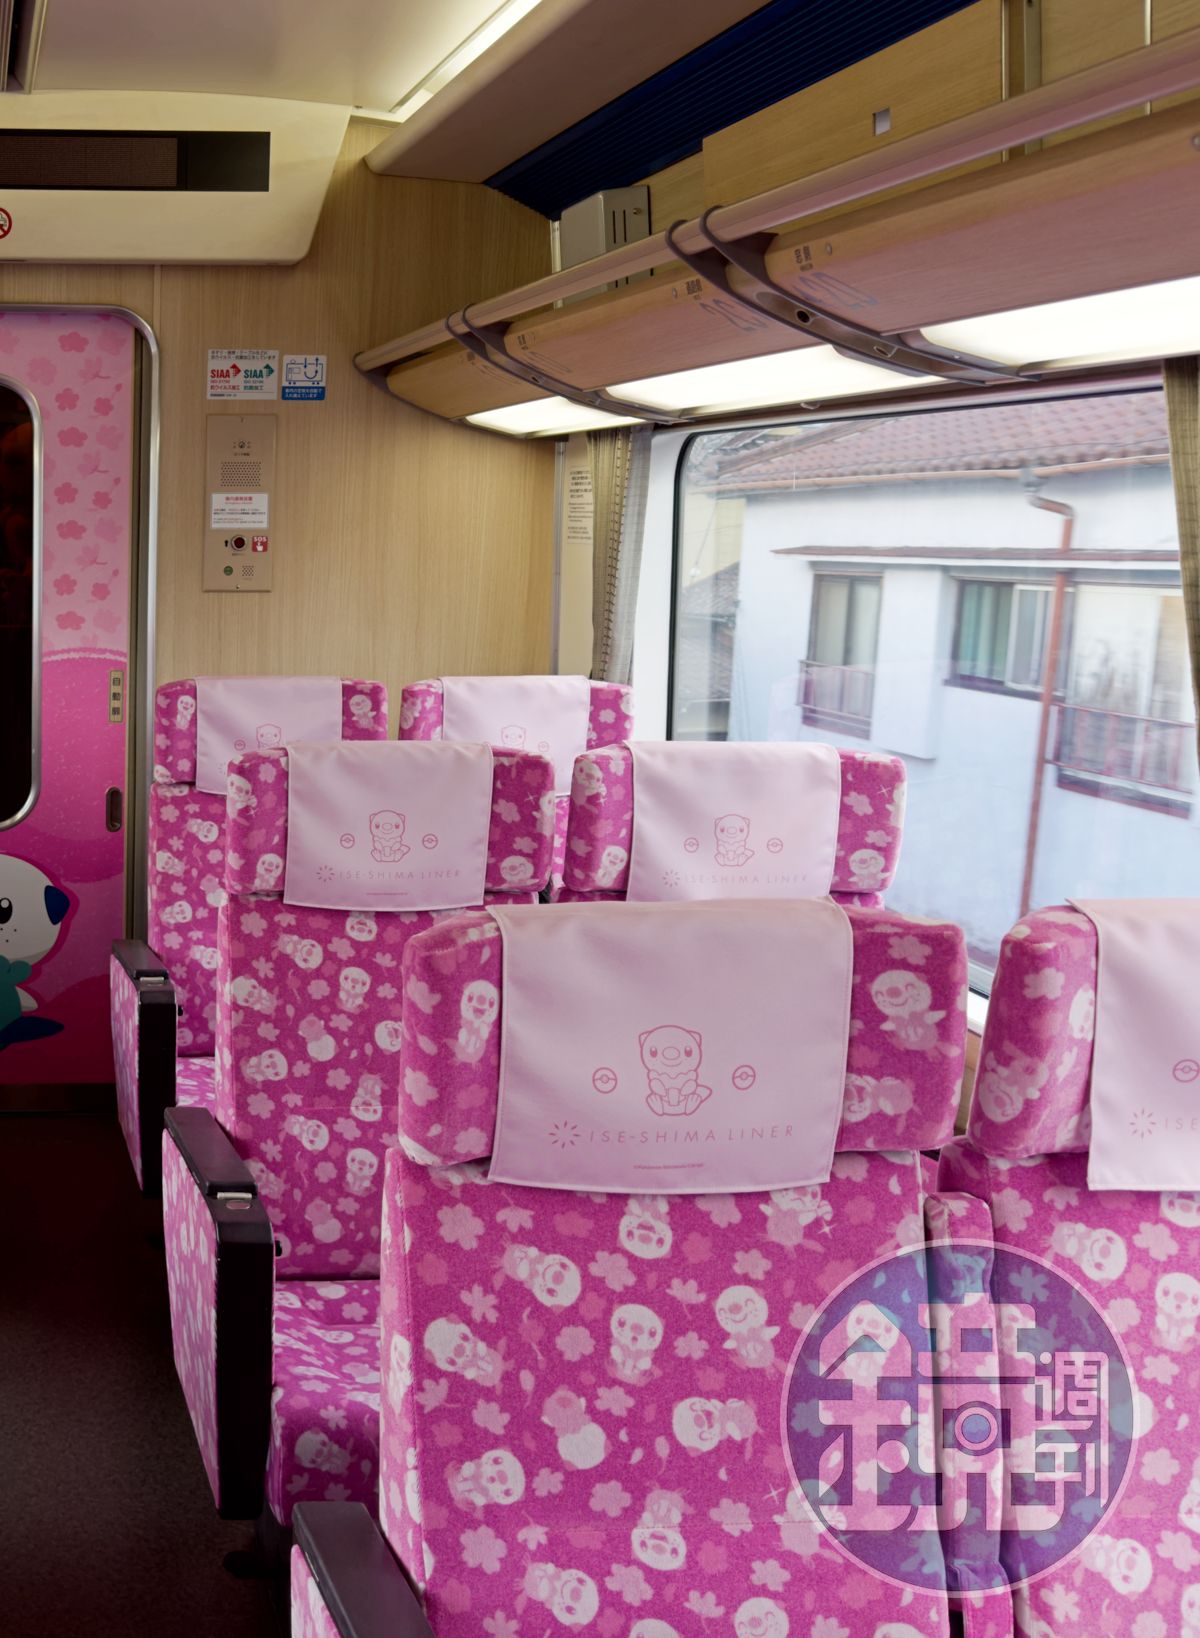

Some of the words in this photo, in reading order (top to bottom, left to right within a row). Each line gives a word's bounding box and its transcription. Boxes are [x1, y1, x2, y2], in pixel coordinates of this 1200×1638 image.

[210, 368, 230, 379] SIAA
[243, 369, 264, 379] SIAA
[589, 1129, 717, 1144] ISE-SHIMA
[728, 1124, 794, 1141] LINER
